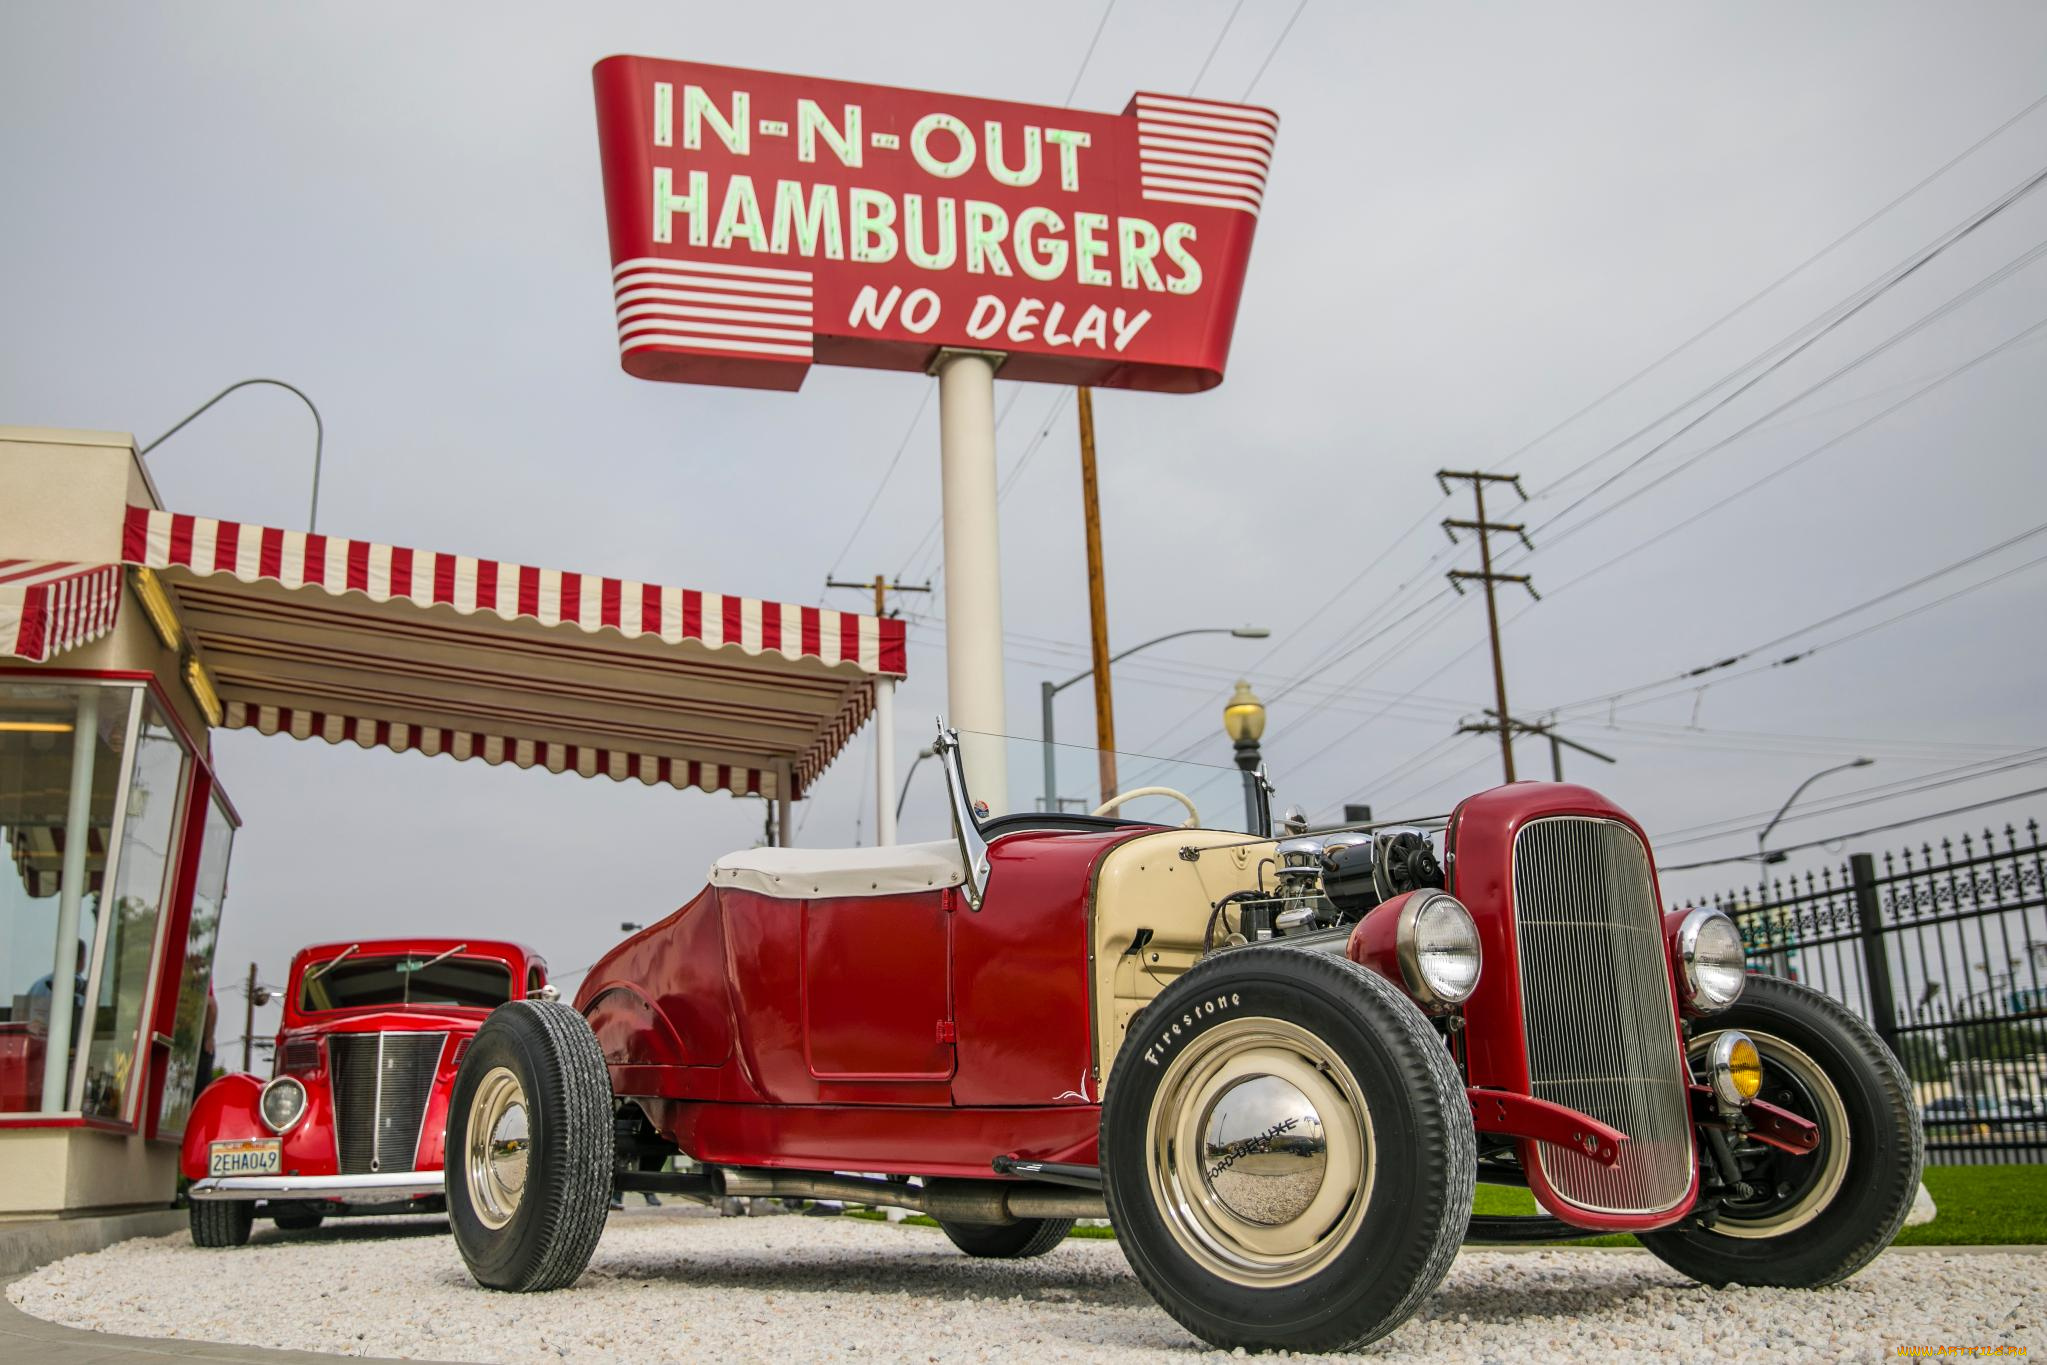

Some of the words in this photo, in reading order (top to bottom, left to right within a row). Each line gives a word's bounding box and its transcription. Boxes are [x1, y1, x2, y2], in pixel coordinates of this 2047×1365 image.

[654, 81, 1091, 193] IN-N-OUT
[653, 166, 1203, 295] HAMBURGERS
[849, 285, 942, 334] NO
[965, 294, 1153, 352] DELAY
[1144, 993, 1240, 1066] Firestone
[213, 1152, 277, 1172] 2EHA049
[1236, 1117, 1299, 1158] DELUXE
